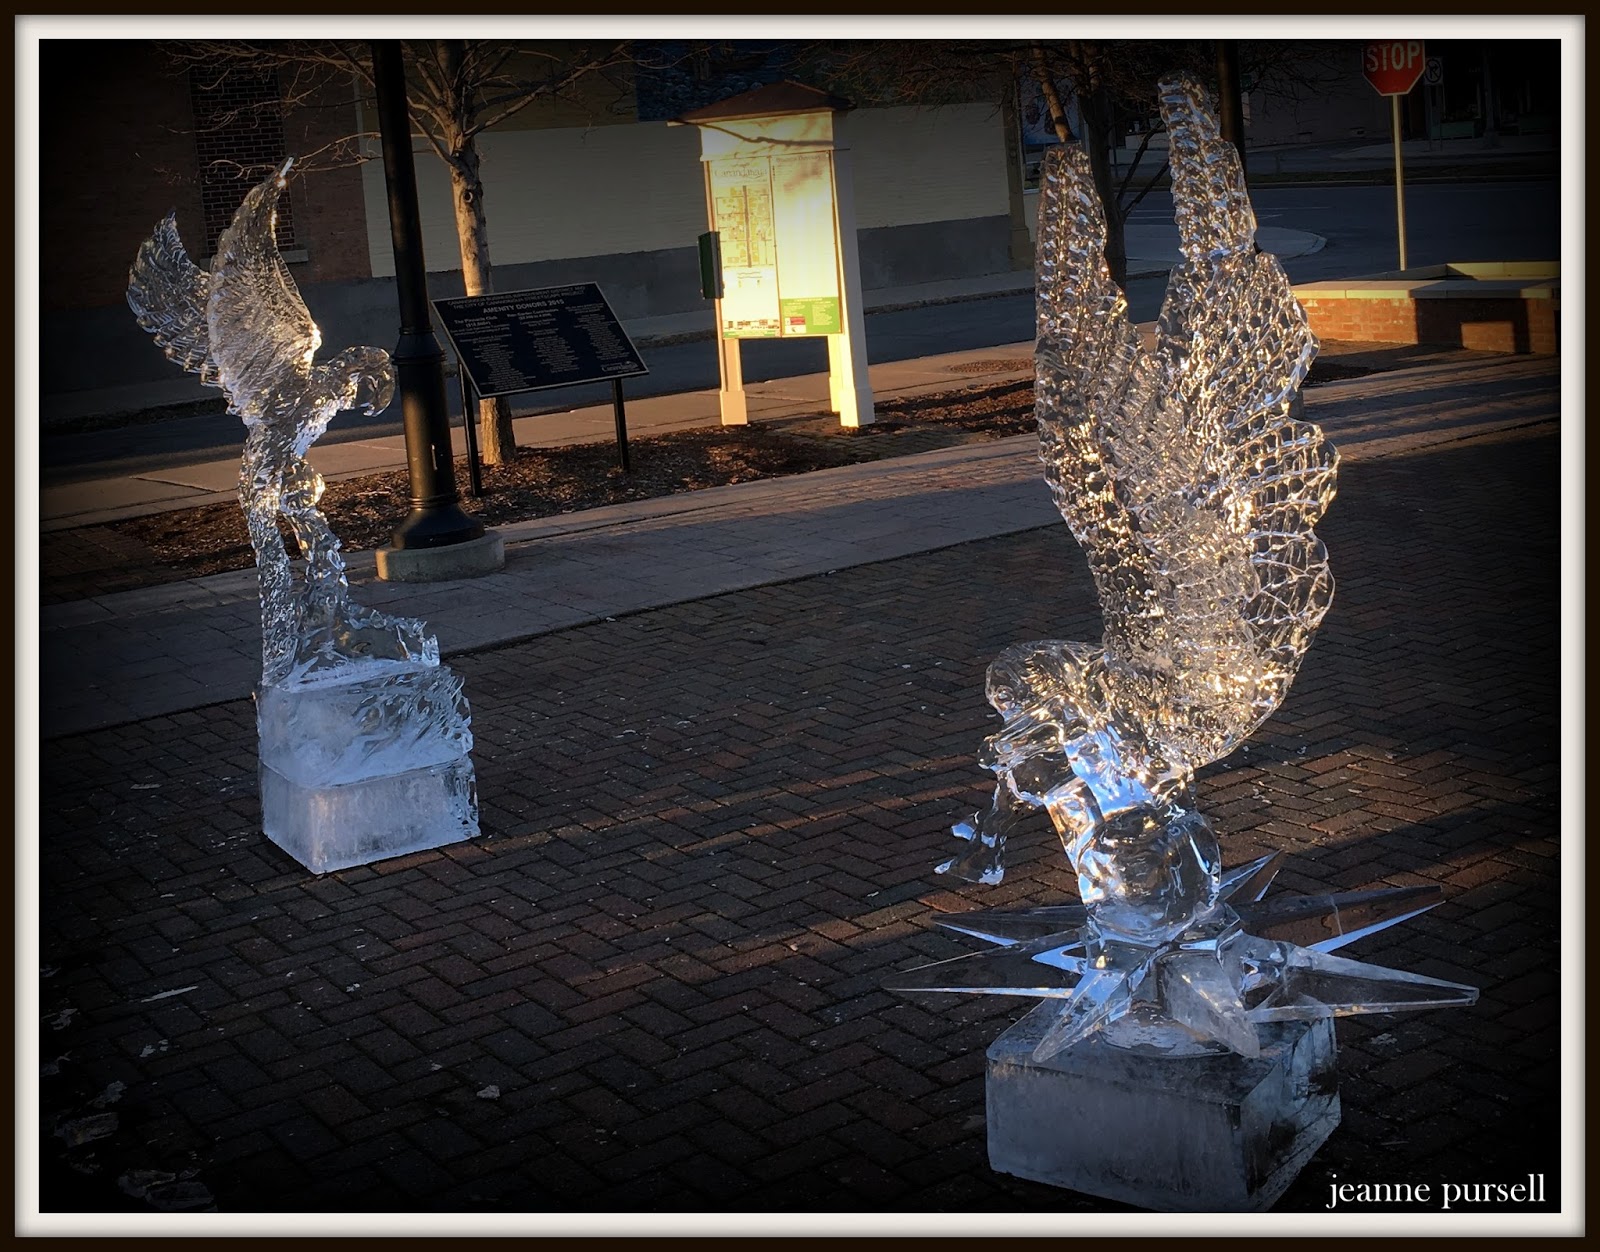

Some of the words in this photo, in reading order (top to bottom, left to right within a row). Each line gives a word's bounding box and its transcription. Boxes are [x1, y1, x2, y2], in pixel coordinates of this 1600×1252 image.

[1366, 41, 1420, 72] STOP
[483, 305, 514, 313] AMENITY
[516, 301, 547, 310] DONORS
